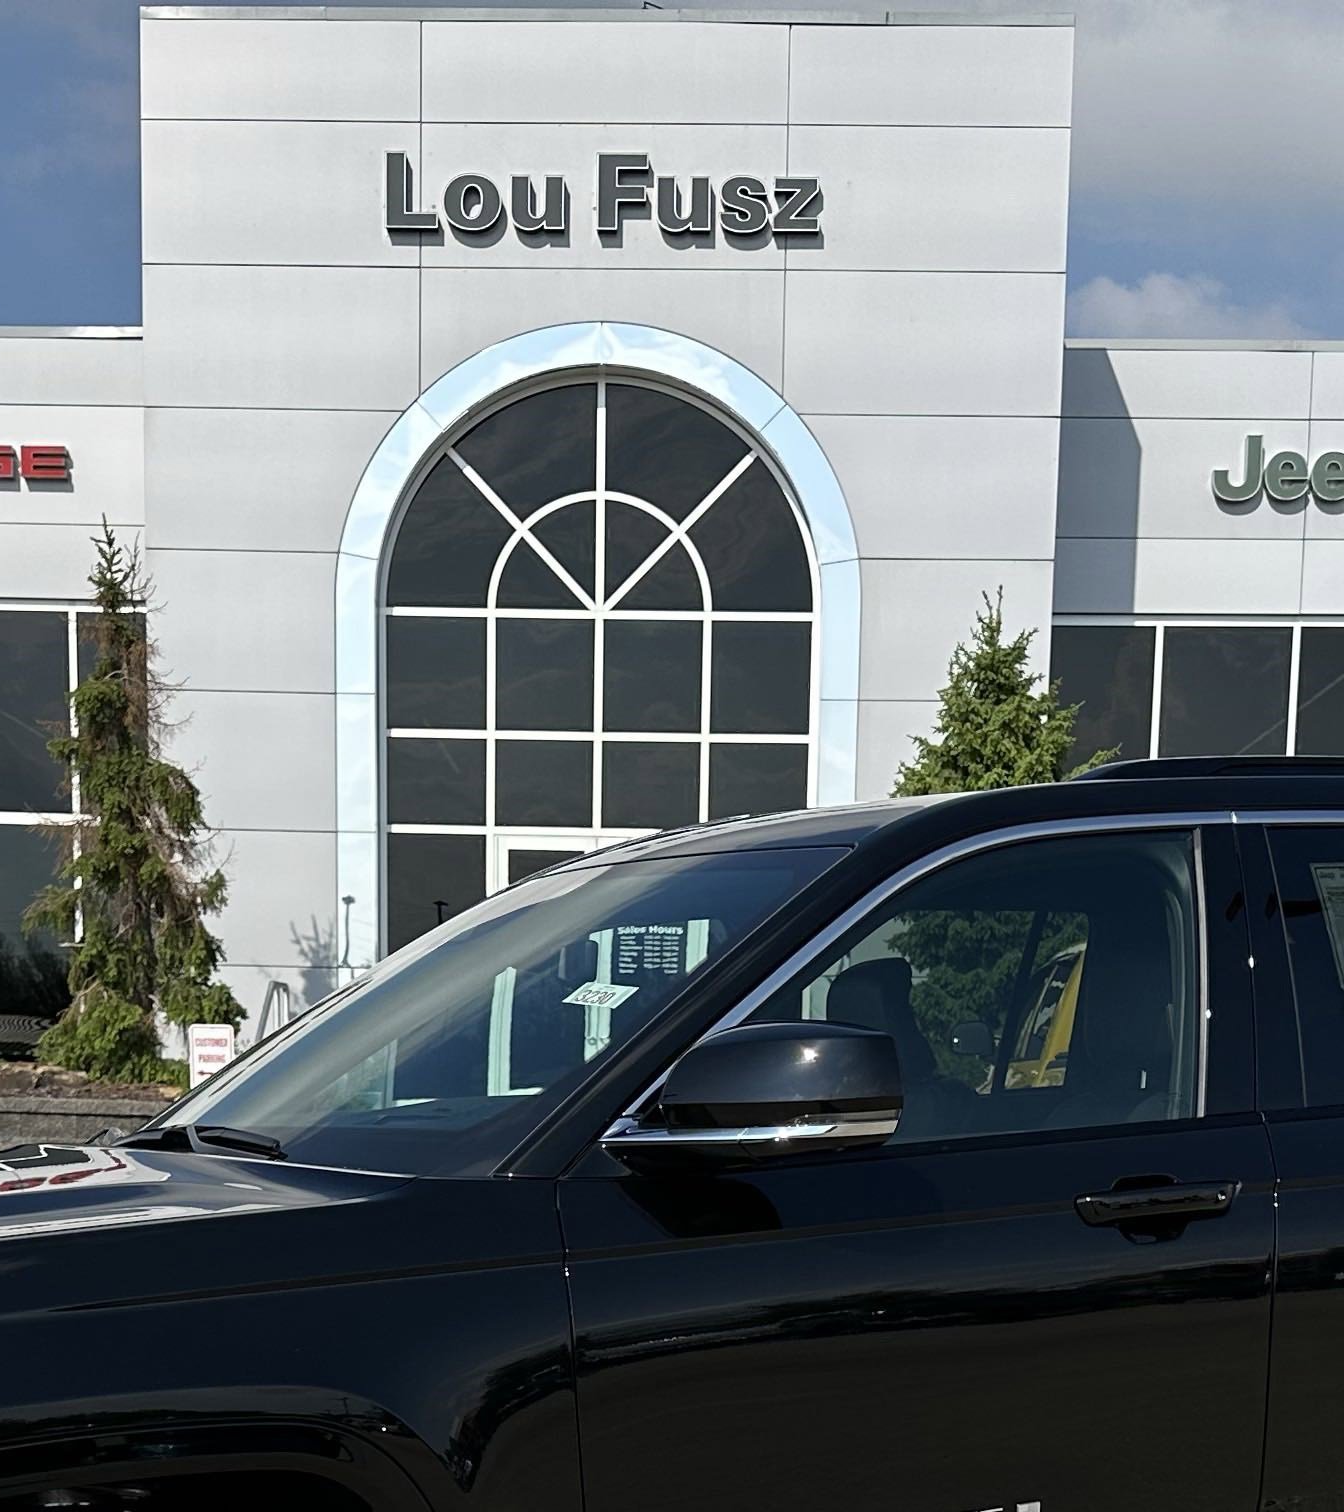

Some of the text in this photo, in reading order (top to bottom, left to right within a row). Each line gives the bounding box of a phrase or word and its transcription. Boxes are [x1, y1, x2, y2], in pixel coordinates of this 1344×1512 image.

[384, 150, 822, 234] Lou Fusz
[617, 925, 684, 935] Sales Hours
